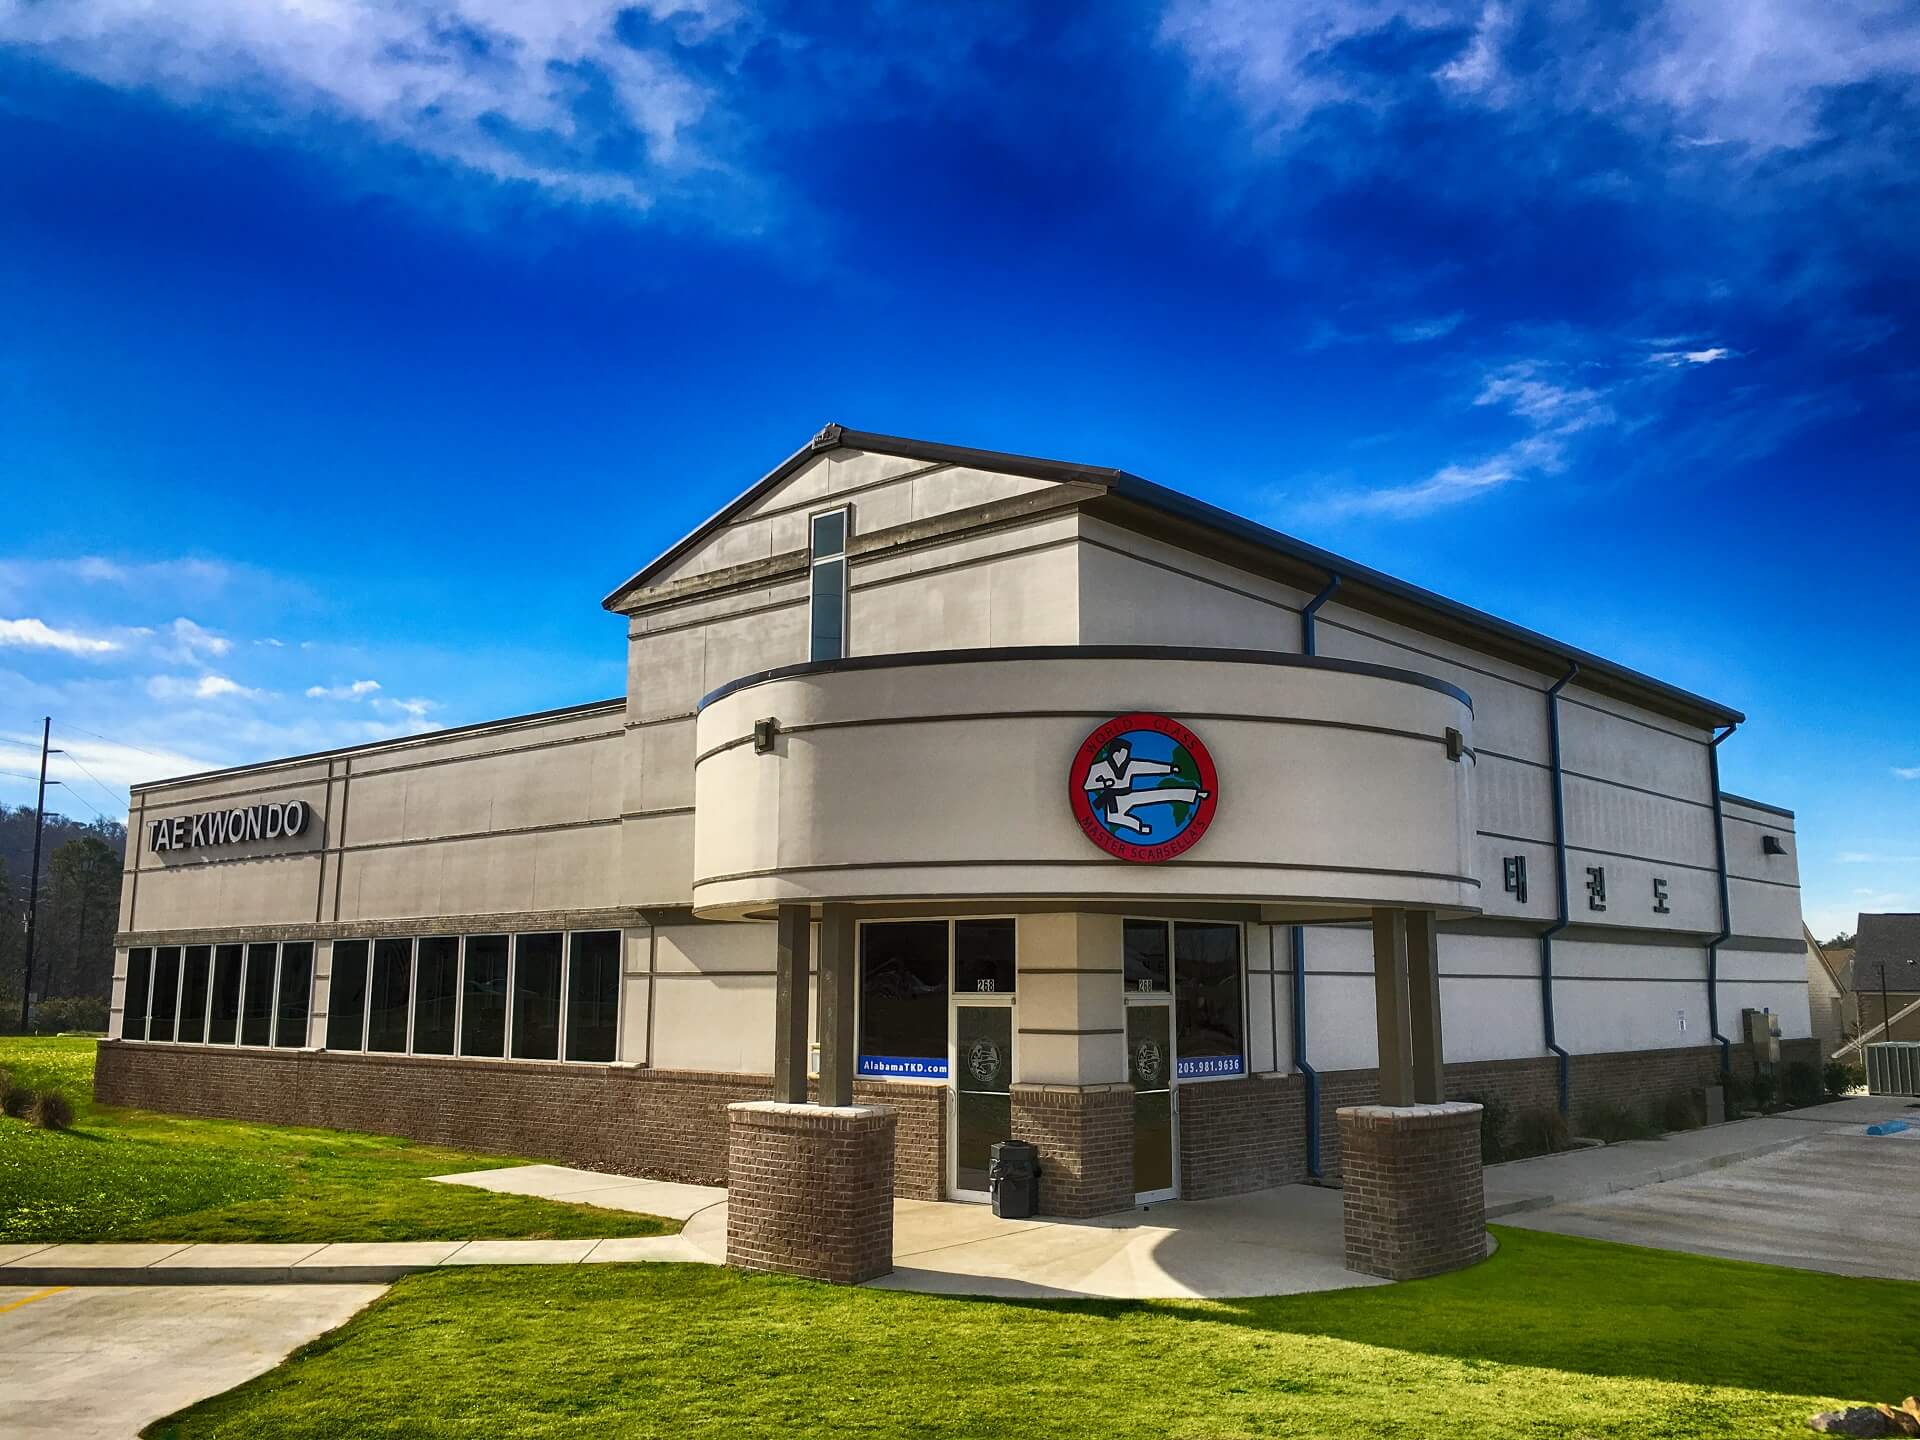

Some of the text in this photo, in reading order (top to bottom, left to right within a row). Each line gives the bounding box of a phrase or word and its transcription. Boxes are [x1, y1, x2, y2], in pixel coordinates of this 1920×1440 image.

[1085, 718, 1199, 753] WORLD CLASS
[1081, 815, 1125, 855] MASTER
[977, 979, 995, 993] 268
[863, 1060, 948, 1074] AlabamaTKD.com
[1178, 1058, 1240, 1074] 205.981.9636
